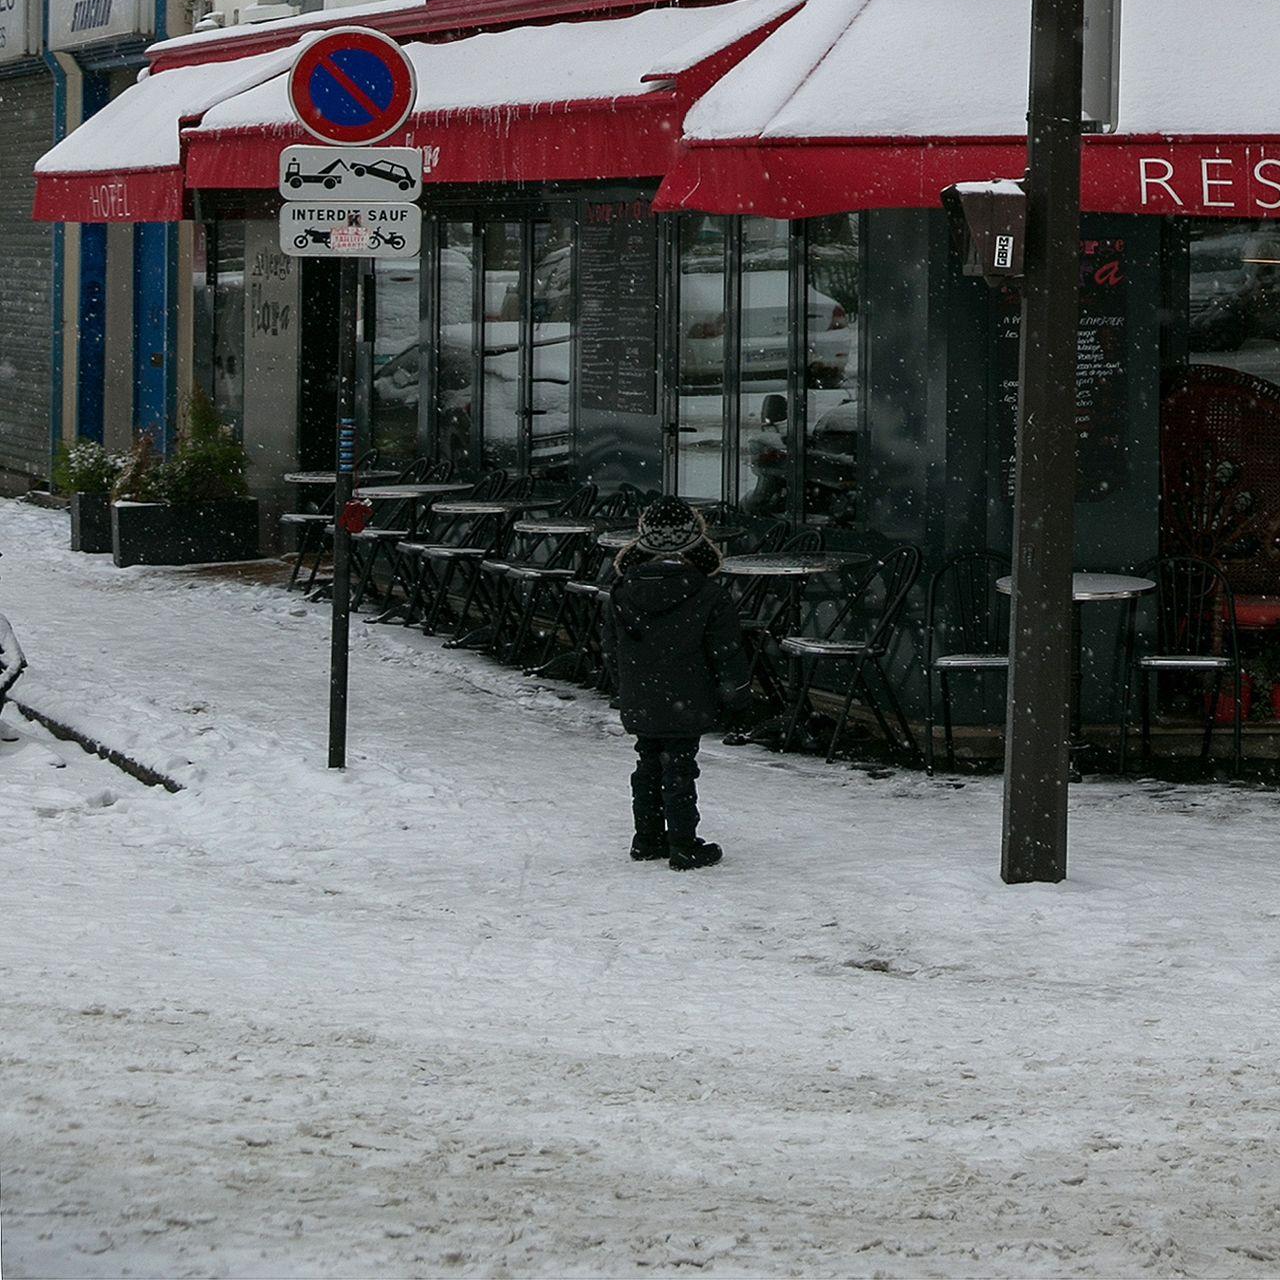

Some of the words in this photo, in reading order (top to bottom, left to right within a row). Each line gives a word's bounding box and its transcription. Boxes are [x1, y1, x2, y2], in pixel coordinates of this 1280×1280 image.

[90, 183, 131, 218] HOTEL
[292, 209, 361, 221] INTERD
[368, 209, 409, 221] SAUF
